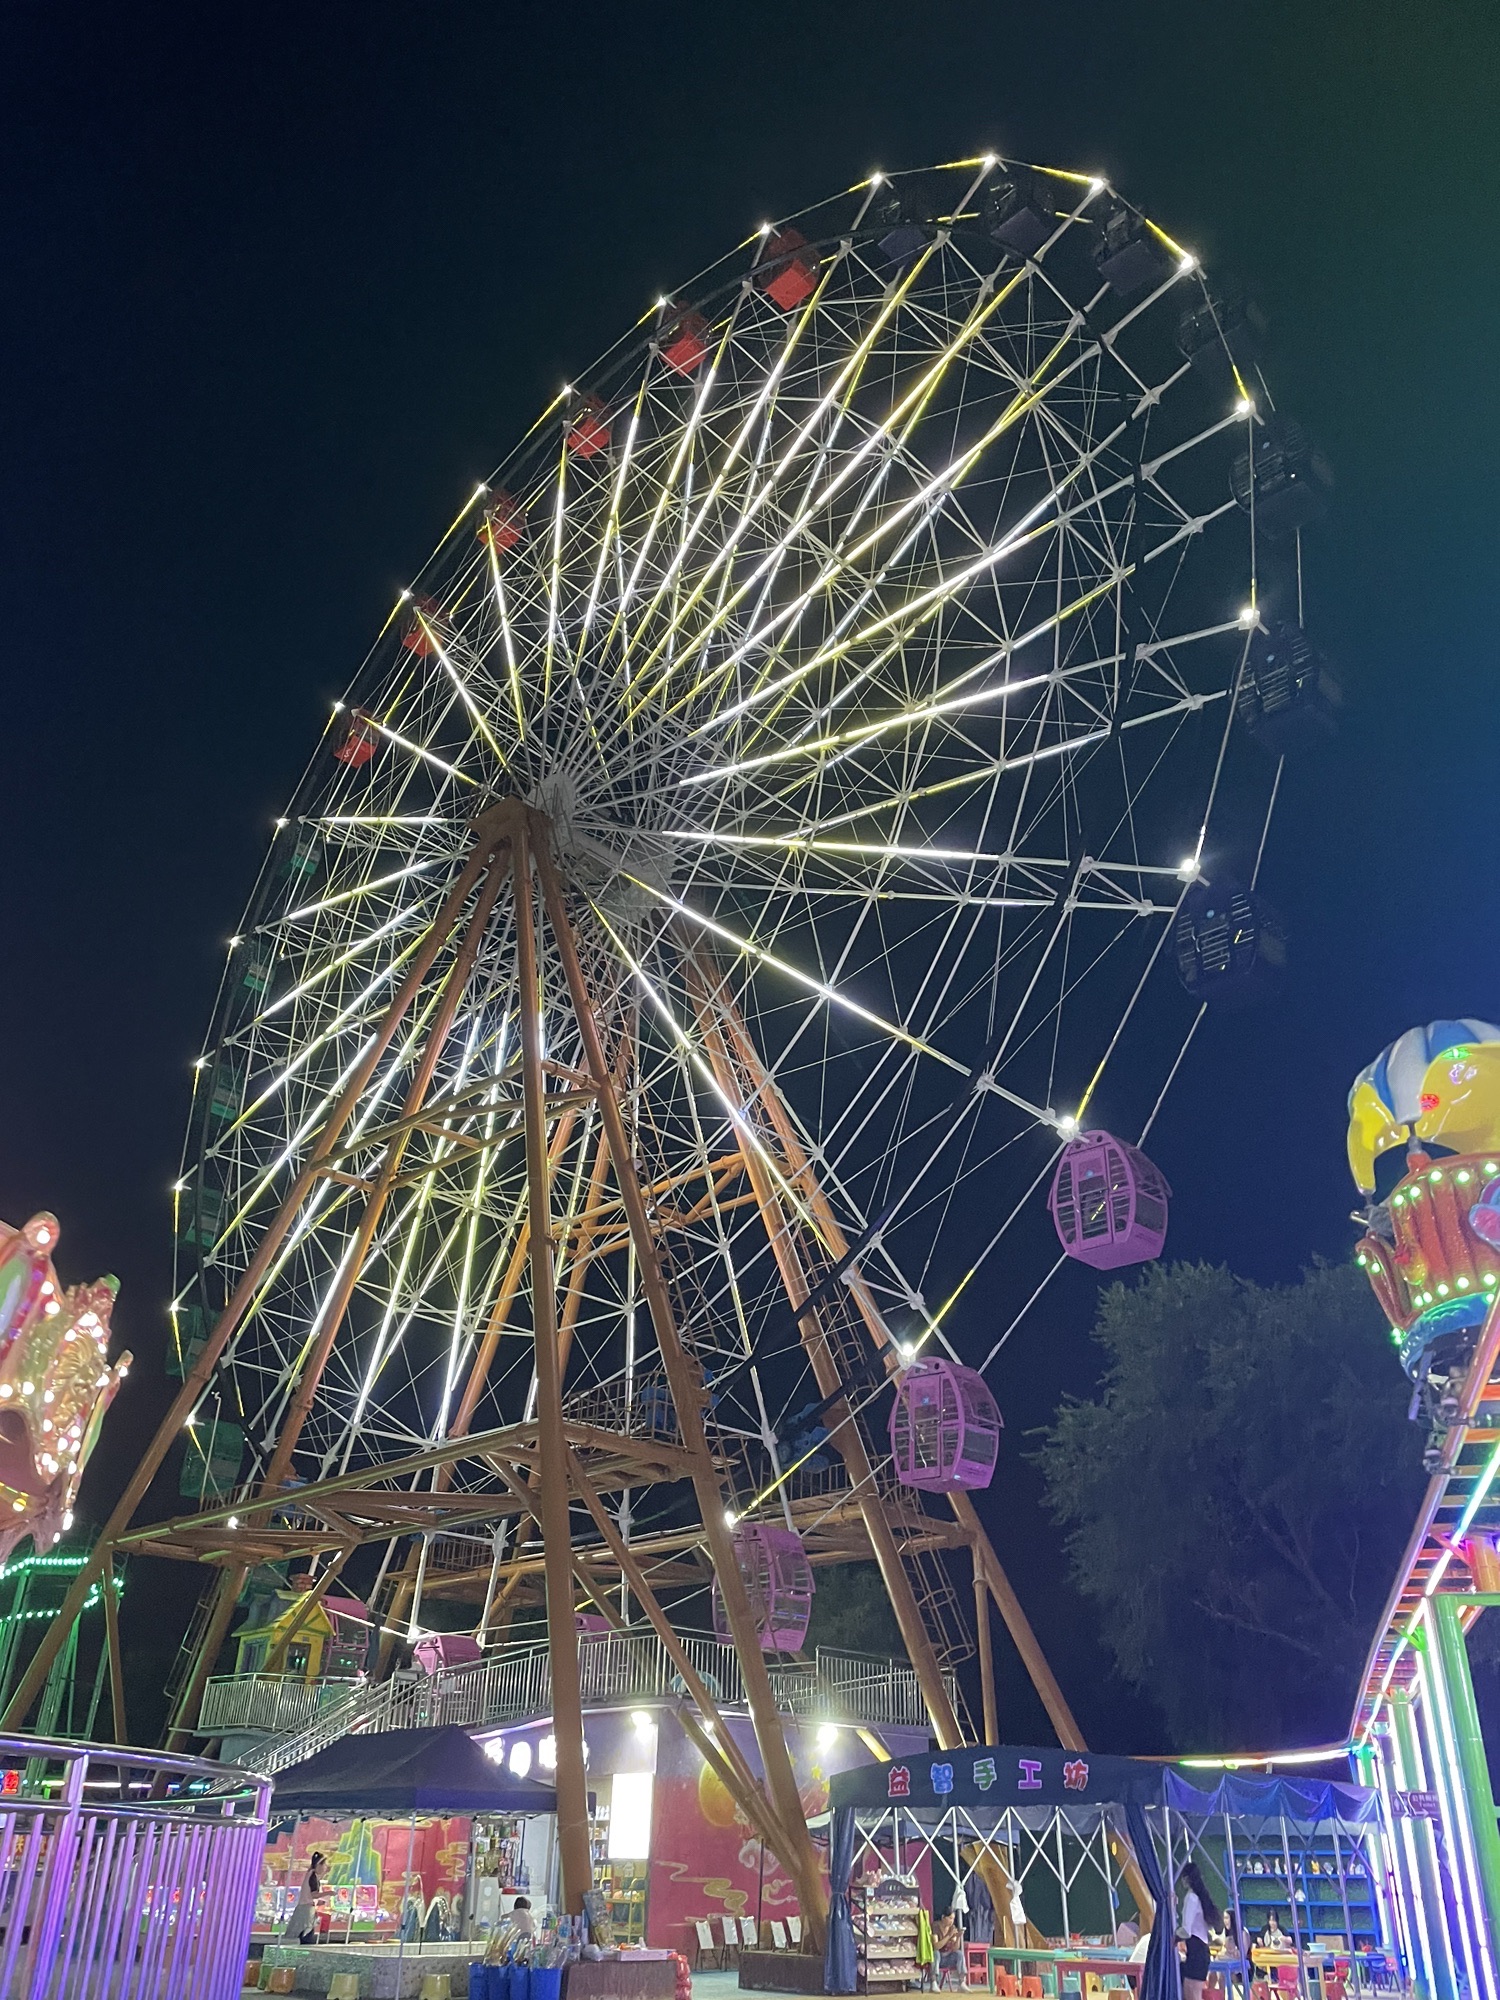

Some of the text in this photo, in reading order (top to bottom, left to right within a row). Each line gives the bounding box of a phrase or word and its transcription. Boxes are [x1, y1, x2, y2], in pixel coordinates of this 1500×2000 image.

[888, 1757, 1089, 1797] 益智手工坊
